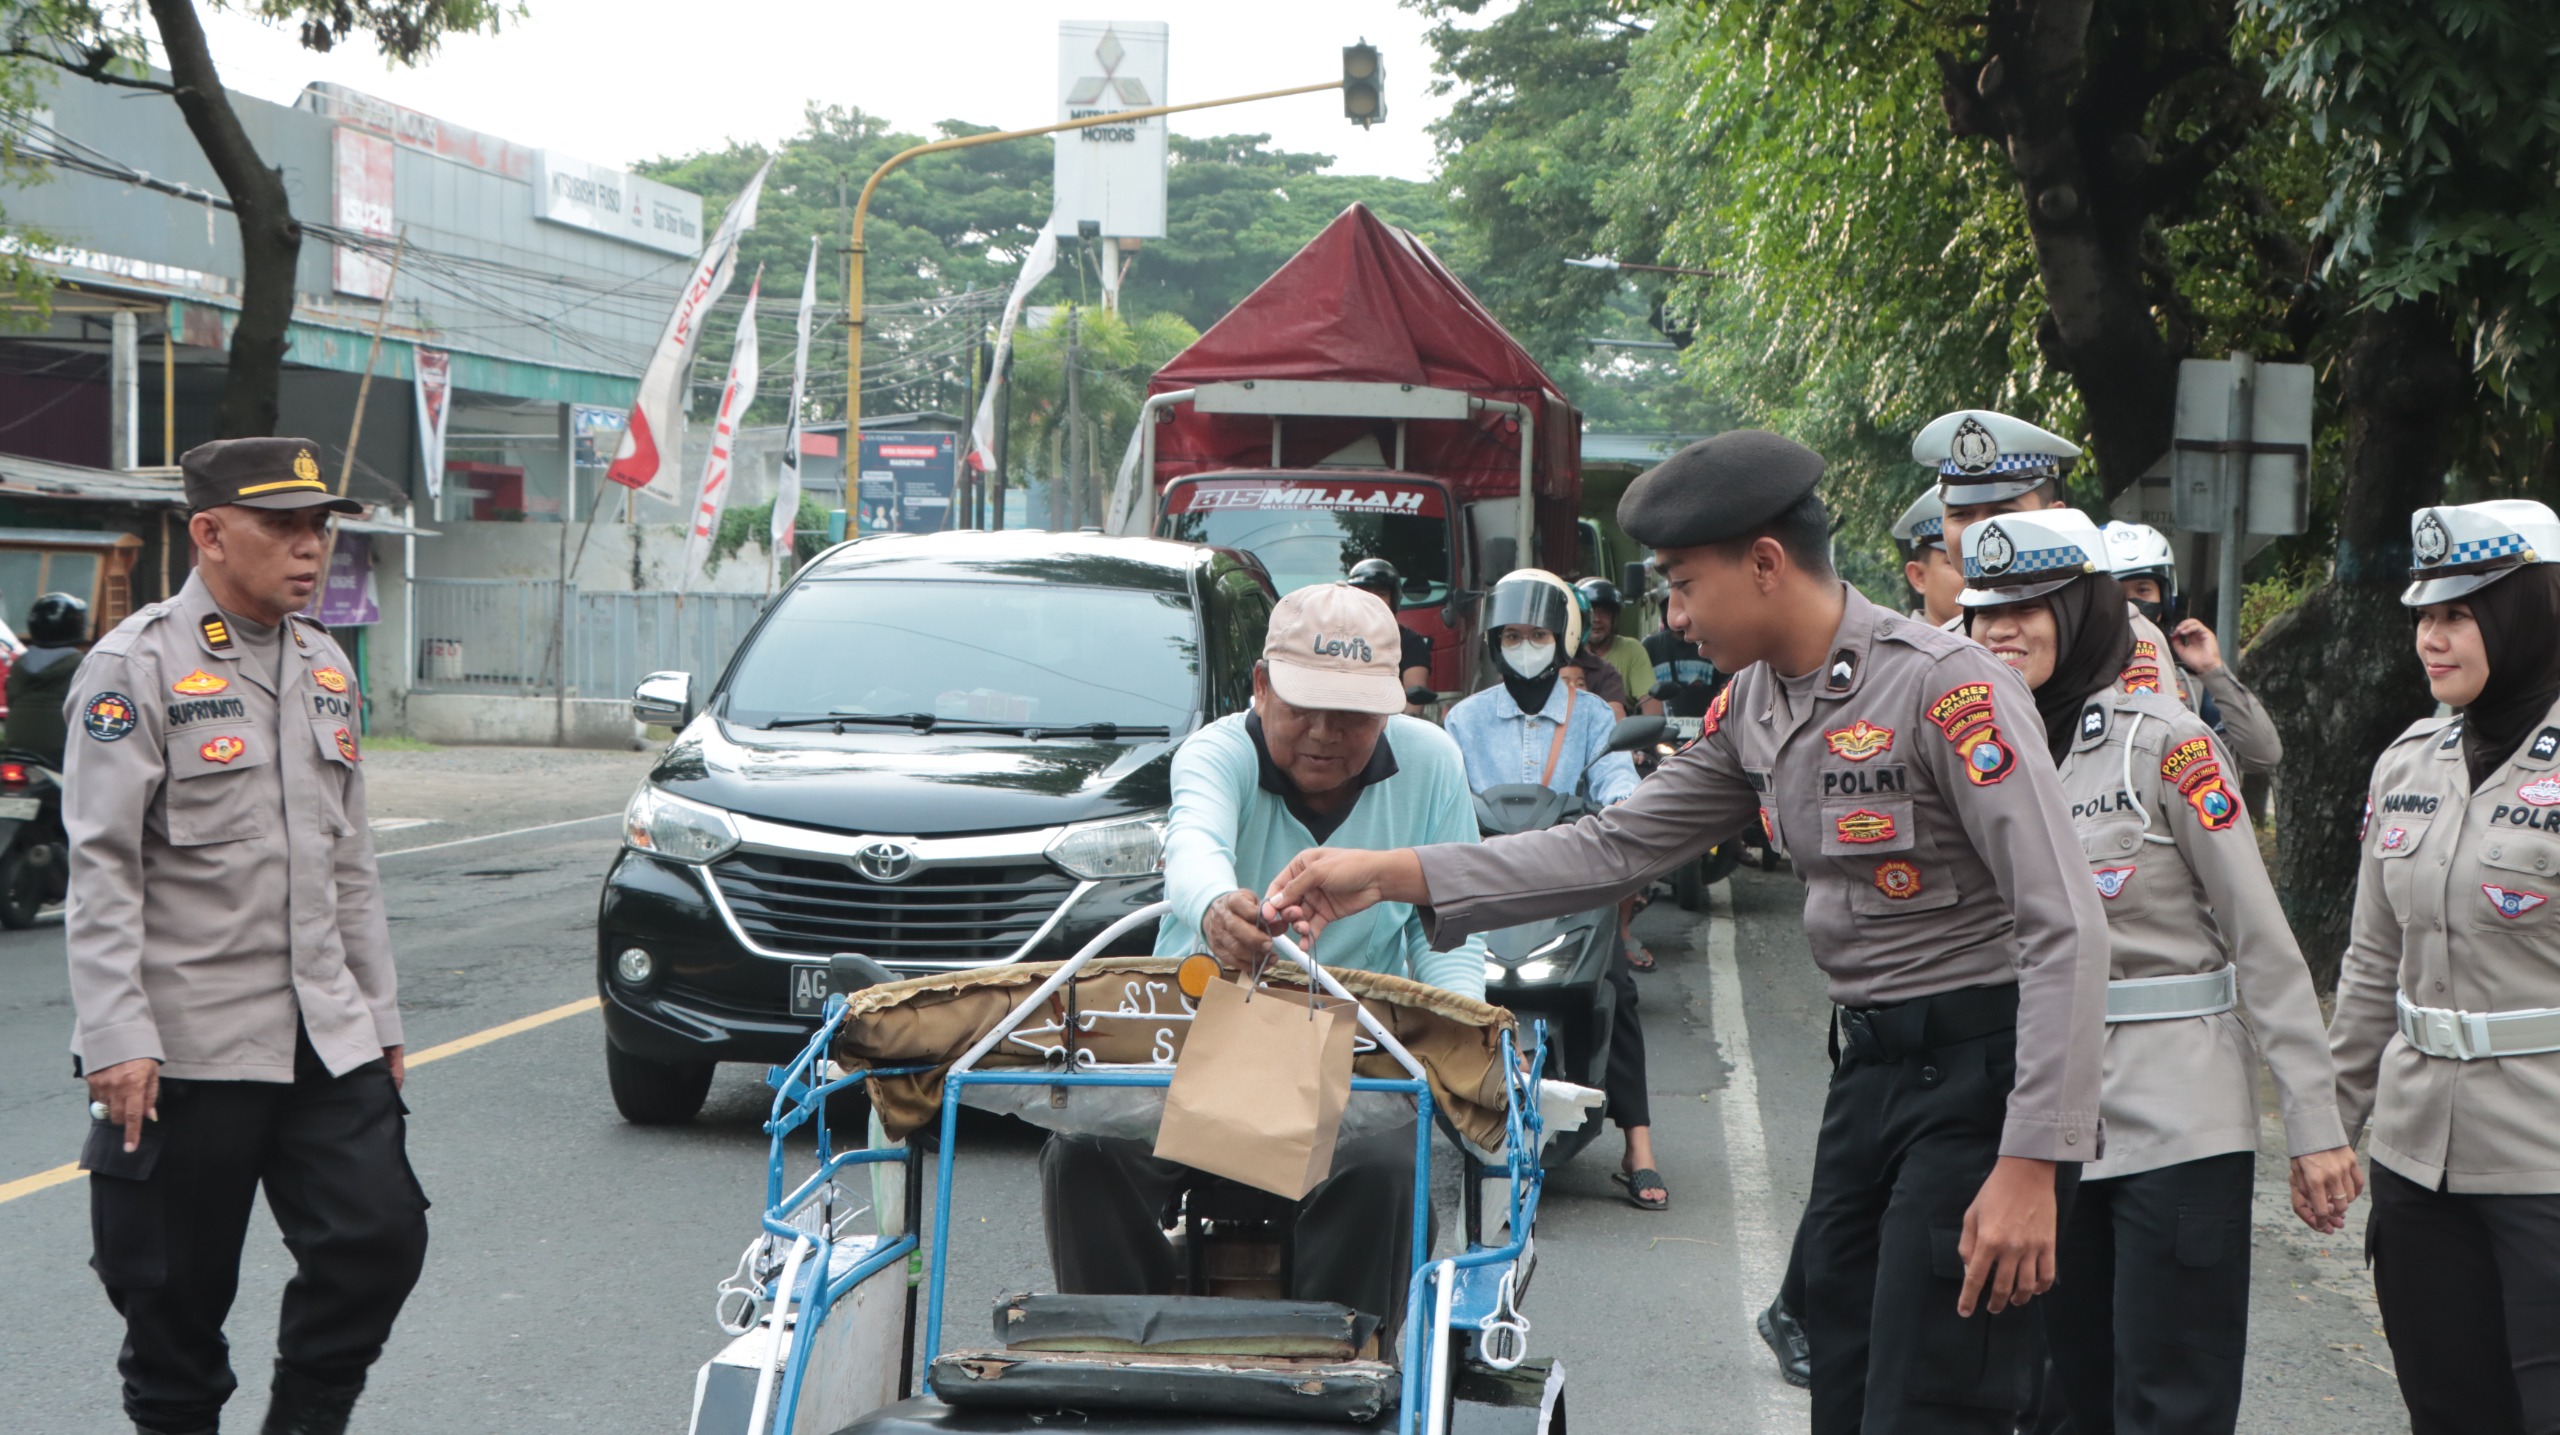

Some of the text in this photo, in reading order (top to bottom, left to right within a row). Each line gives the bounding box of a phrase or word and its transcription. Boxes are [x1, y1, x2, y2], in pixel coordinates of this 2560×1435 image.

[1082, 127, 1135, 142] MOTORS
[599, 184, 620, 214] FUSO
[341, 200, 391, 234] ISUZU
[1188, 488, 1424, 509] BISMILLAH
[1311, 505, 1351, 513] MUGI
[1354, 506, 1418, 515] BERKAH
[1313, 633, 1372, 663] Levi's
[2125, 669, 2140, 677] JAWA
[1932, 686, 1988, 717] POLRES
[1941, 694, 1982, 718] NGANJUK
[1949, 711, 1990, 736] JAWA TIMUR
[2161, 740, 2207, 775] POLRES
[2171, 749, 2209, 779] NGANJUK
[1824, 769, 1905, 795] POLRI
[2182, 765, 2217, 792] JAWA TIMUR
[2072, 791, 2142, 820] POLRI
[2383, 794, 2438, 814] NANING
[2490, 804, 2560, 833] POLR
[796, 969, 827, 999] AG
